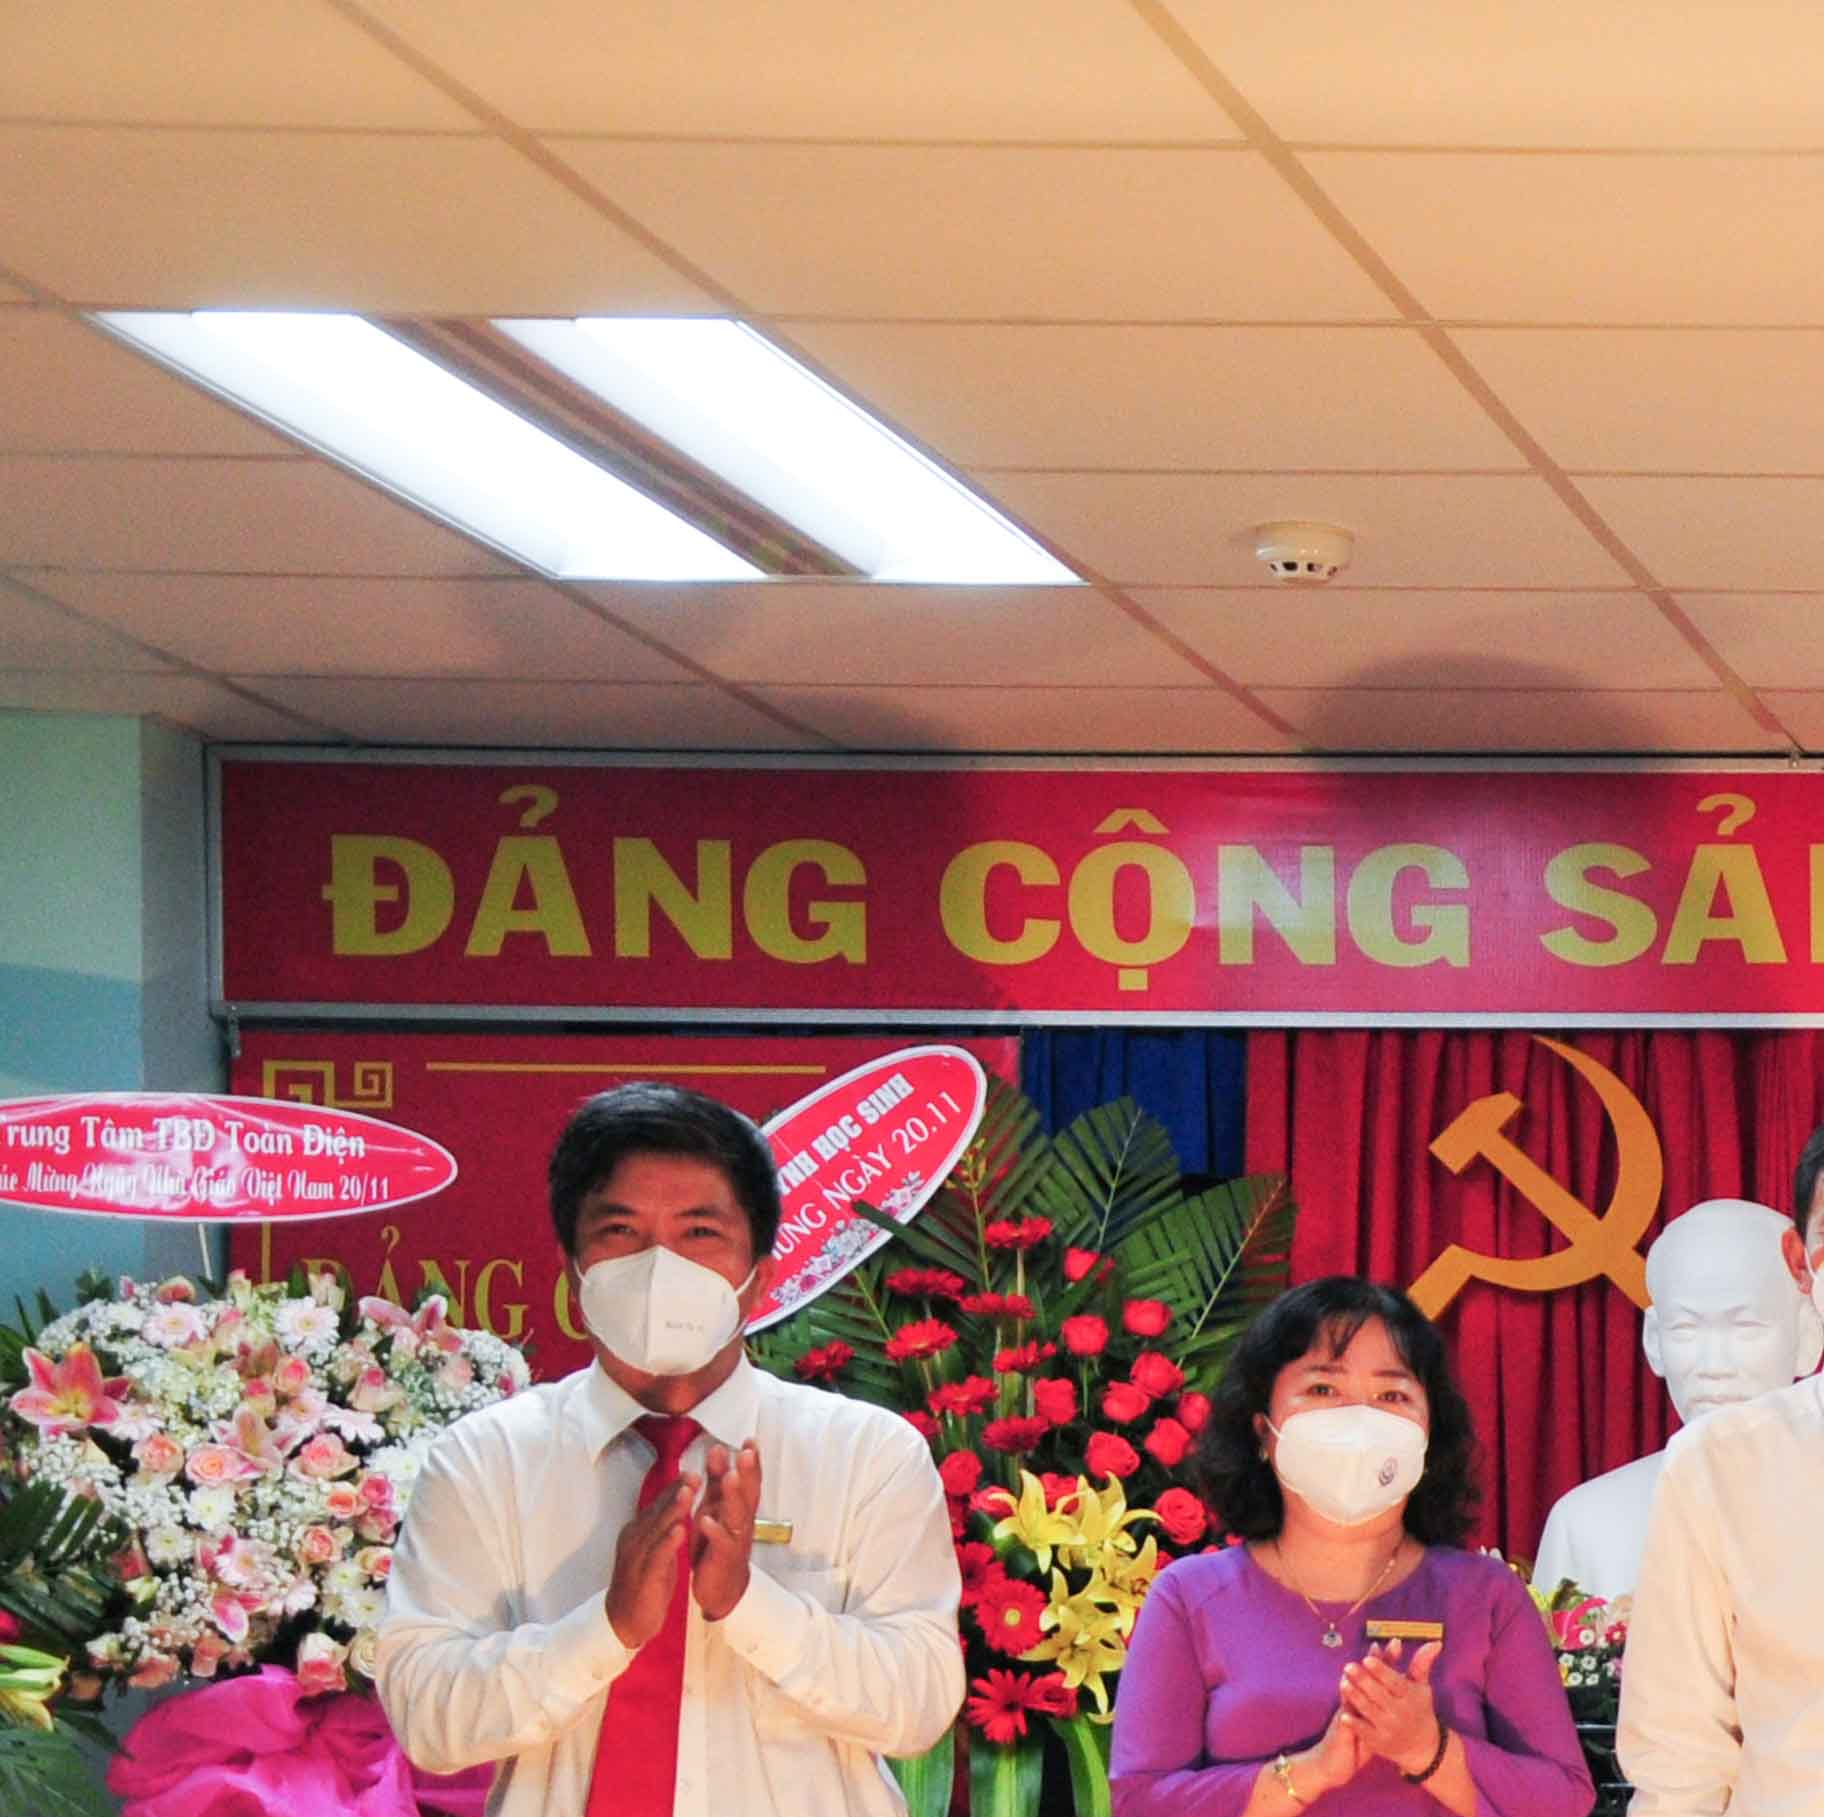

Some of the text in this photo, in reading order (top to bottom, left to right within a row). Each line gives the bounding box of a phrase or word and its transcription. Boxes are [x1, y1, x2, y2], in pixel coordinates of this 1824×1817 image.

[324, 785, 867, 966] ĐẢNG
[938, 807, 1471, 991] CỘNG
[856, 1072, 915, 1126] SINH
[6, 1124, 71, 1155] rung
[80, 1115, 145, 1150] Tâm
[223, 1120, 294, 1156] Toàn
[302, 1123, 366, 1166] Điện
[821, 1143, 893, 1211] NGÀY
[891, 1089, 962, 1155] 20.11
[339, 1172, 390, 1208] 20/11
